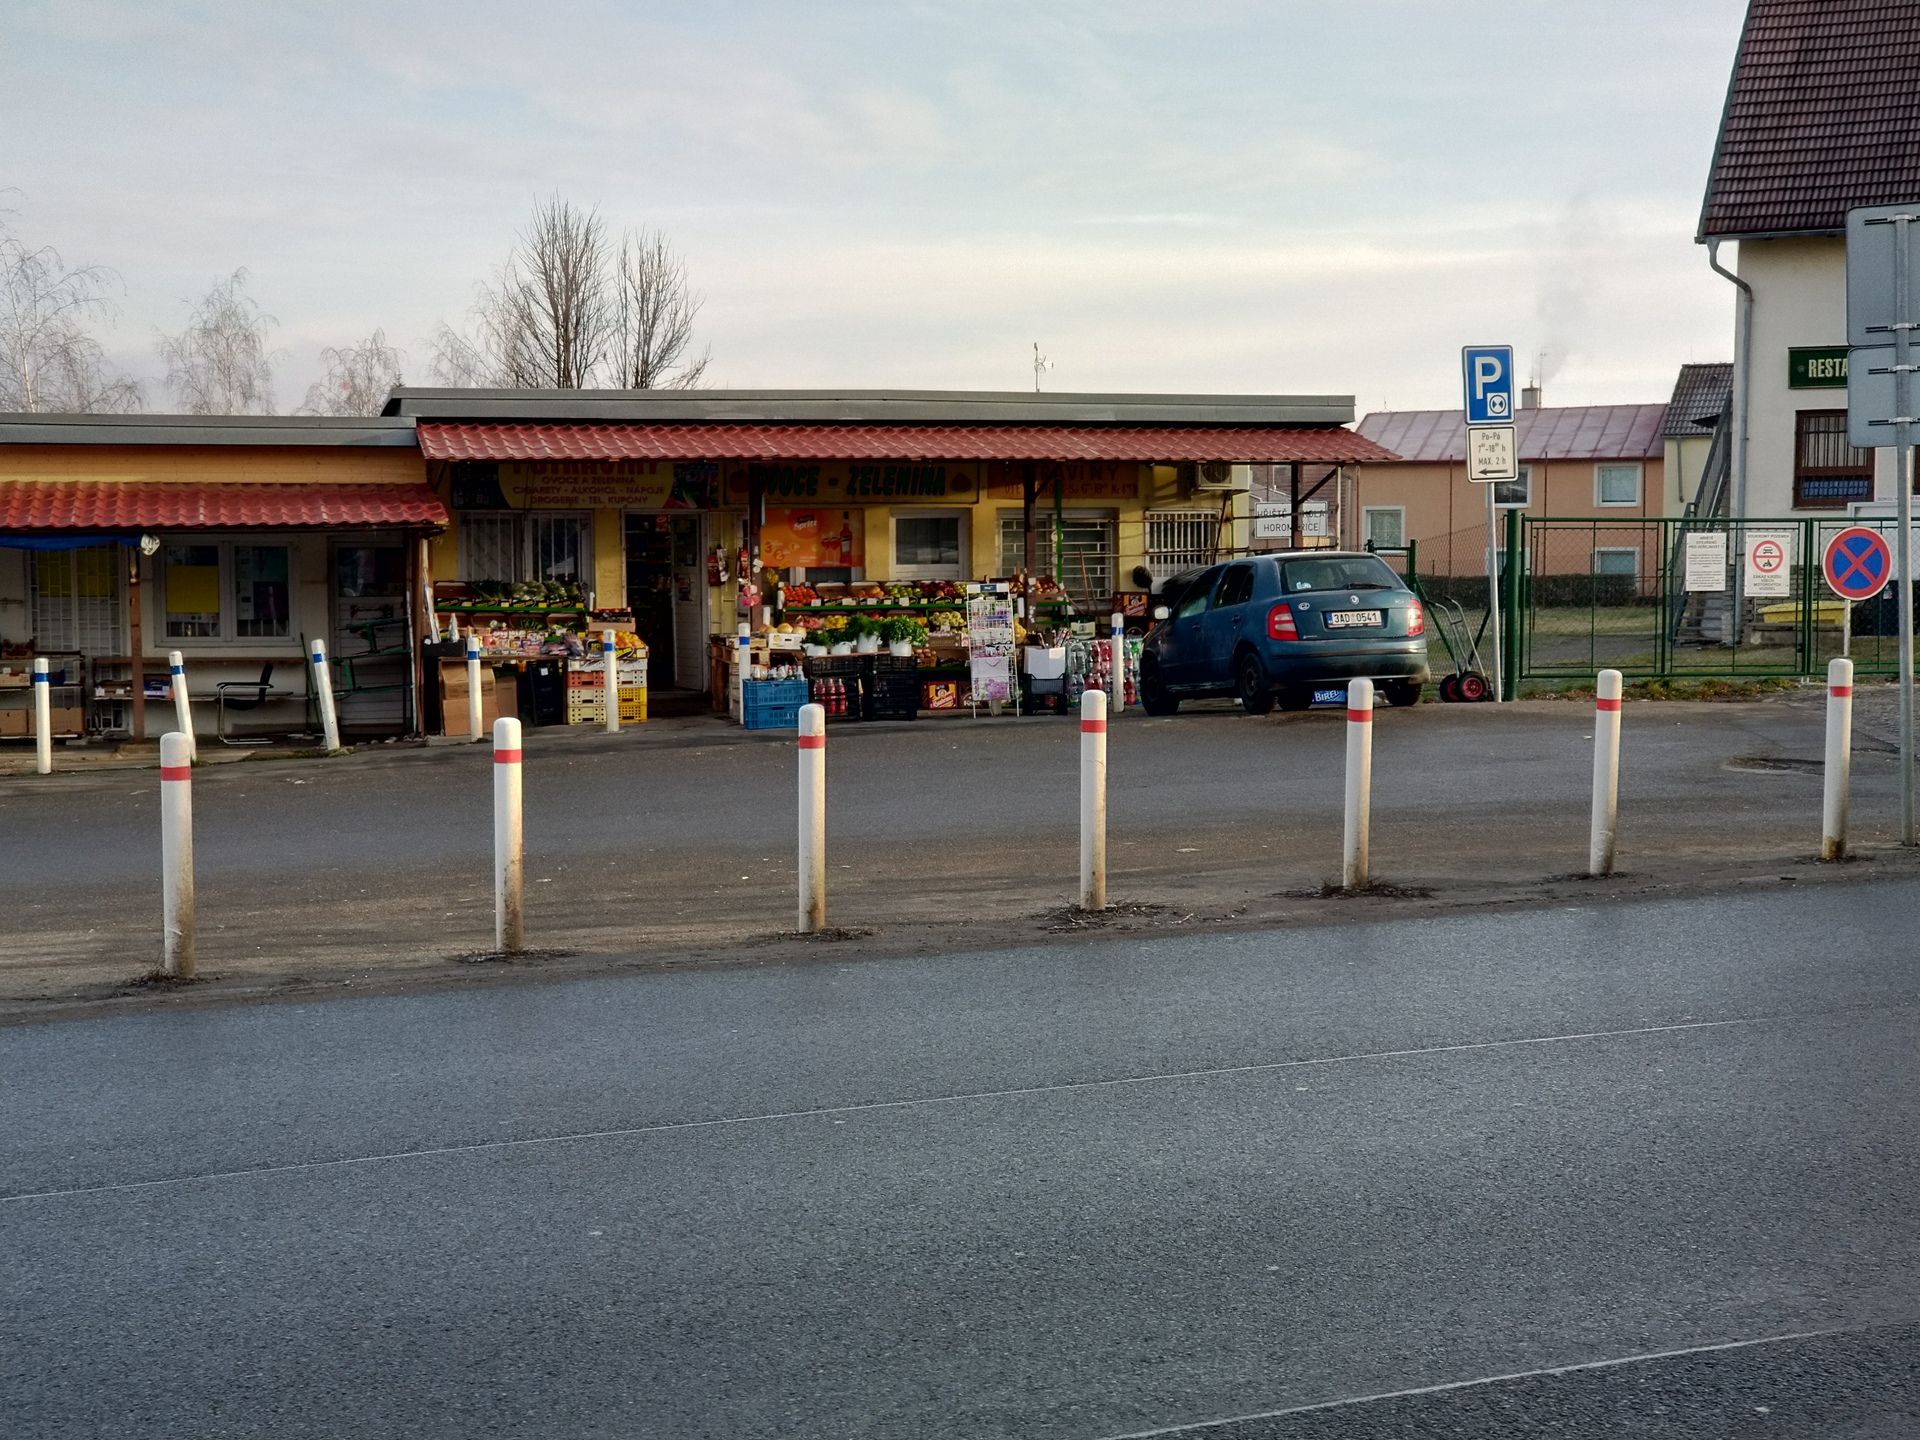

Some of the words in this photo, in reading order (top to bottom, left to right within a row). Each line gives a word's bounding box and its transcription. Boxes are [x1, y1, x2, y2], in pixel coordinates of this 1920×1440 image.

[1808, 358, 1848, 378] RESTA
[1475, 356, 1502, 400] P
[1481, 431, 1501, 441] Po-Pá
[1478, 456, 1494, 466] MAX.
[1495, 456, 1500, 466] 2
[1501, 456, 1507, 465] h
[541, 476, 579, 485] OVOCE
[581, 476, 589, 485] A
[591, 476, 636, 485] ZELENINA
[847, 467, 946, 496] ZELENINA
[513, 486, 562, 495] CIGARETY
[571, 486, 617, 495] ALKOHOL
[530, 496, 580, 504] DROGERIE
[588, 496, 605, 504] TEL.
[608, 494, 649, 504] KUPÓNY
[793, 519, 818, 531] Spritz
[1334, 613, 1351, 623] 3AD
[1356, 612, 1377, 623] 0541
